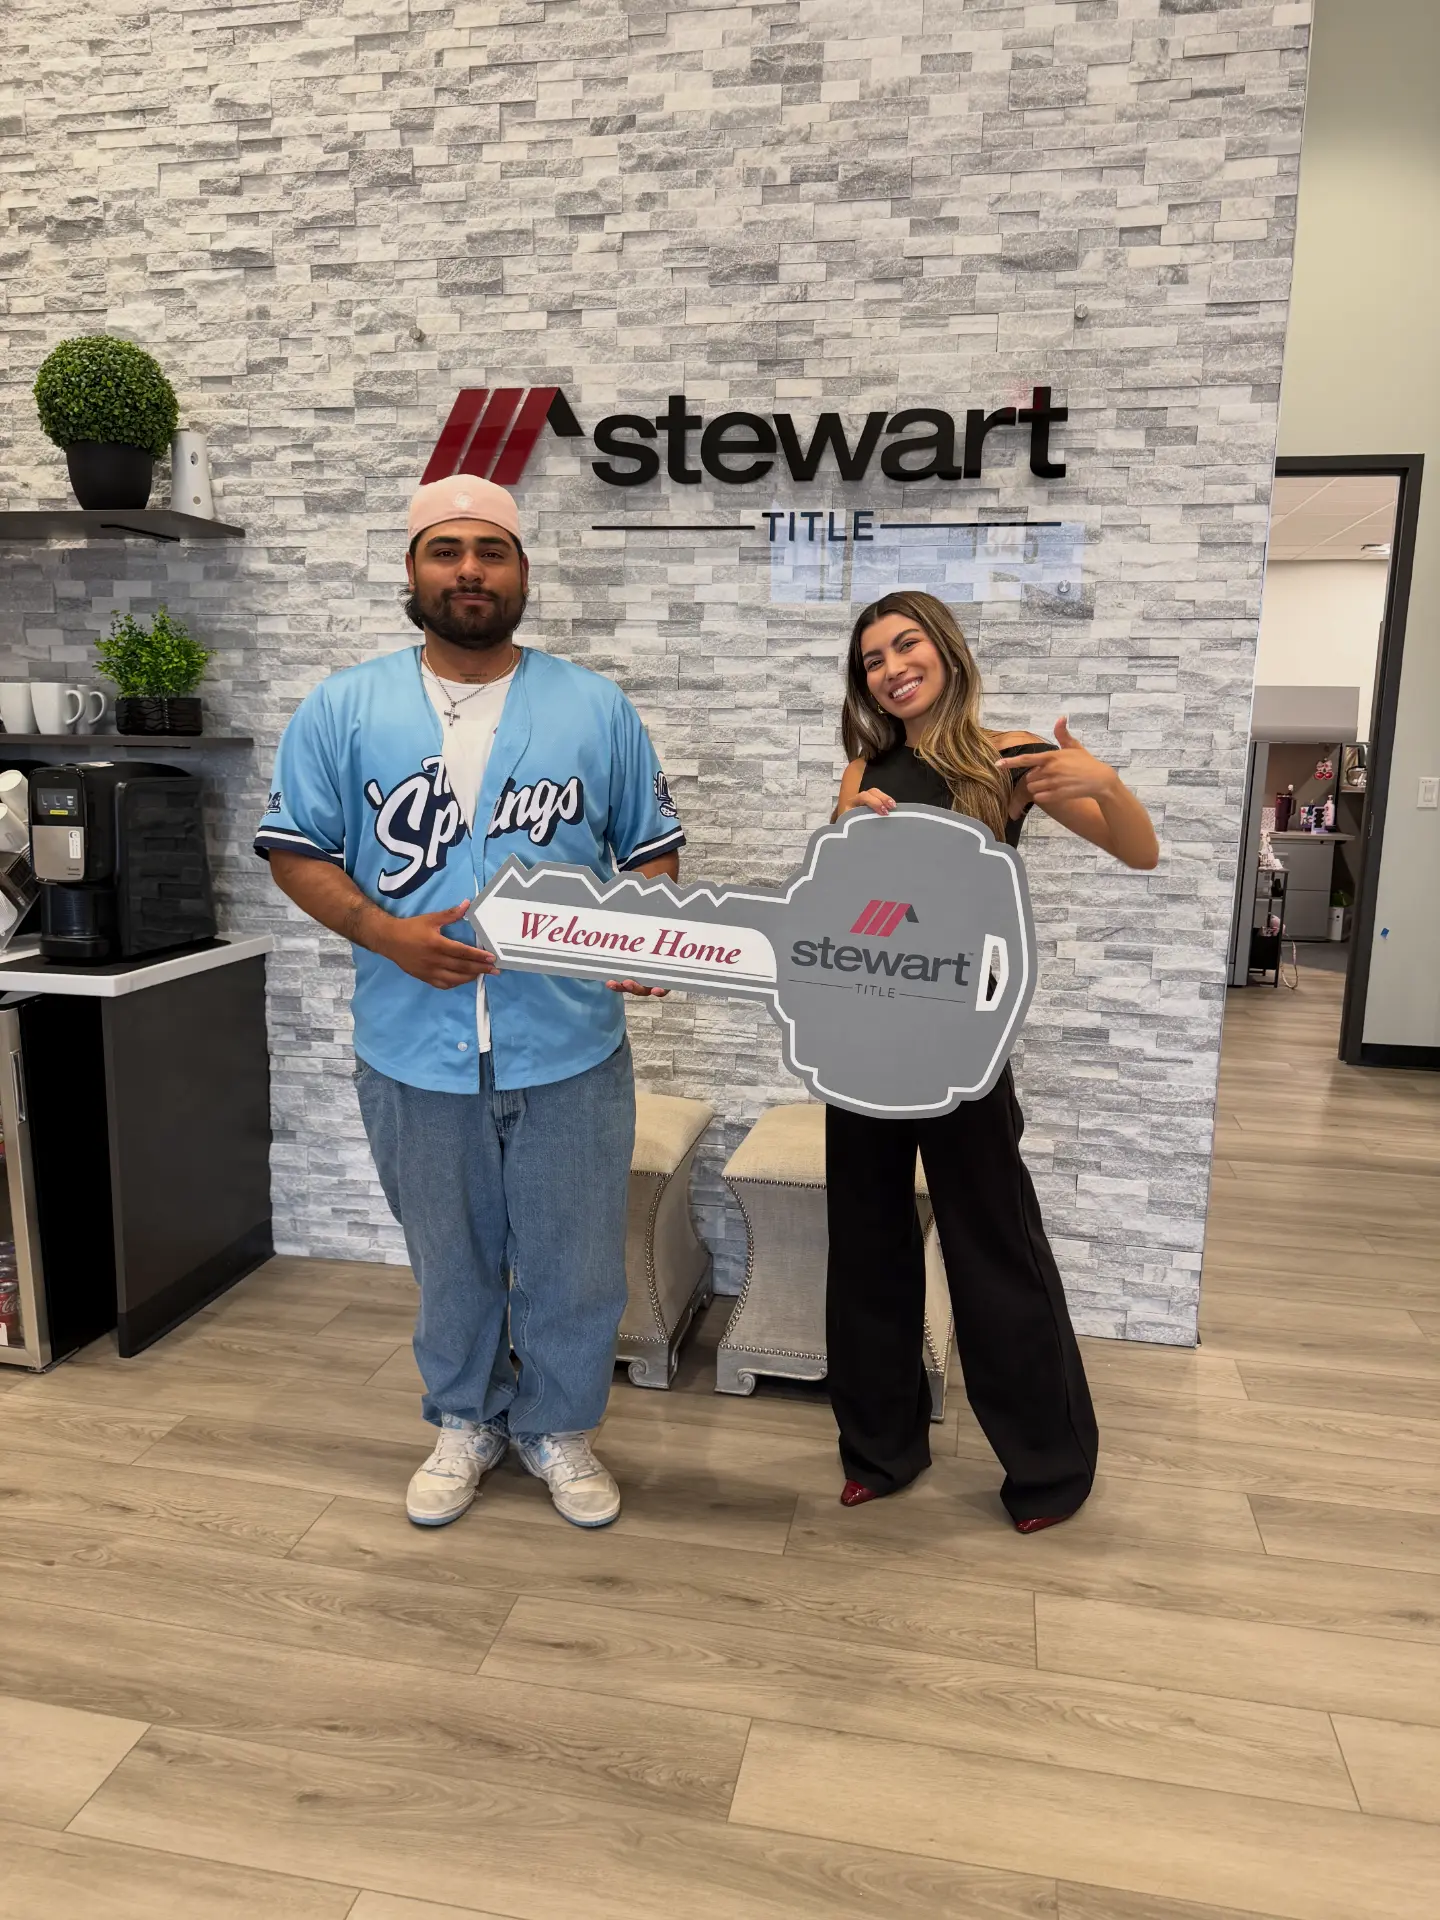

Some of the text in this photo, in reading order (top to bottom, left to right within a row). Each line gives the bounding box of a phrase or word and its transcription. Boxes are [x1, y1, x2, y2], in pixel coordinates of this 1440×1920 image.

[592, 386, 1068, 486] stewart
[762, 511, 873, 542] TITLE
[521, 911, 742, 965] Welcome Home
[791, 936, 971, 986] stewart
[855, 983, 897, 999] TITLE
